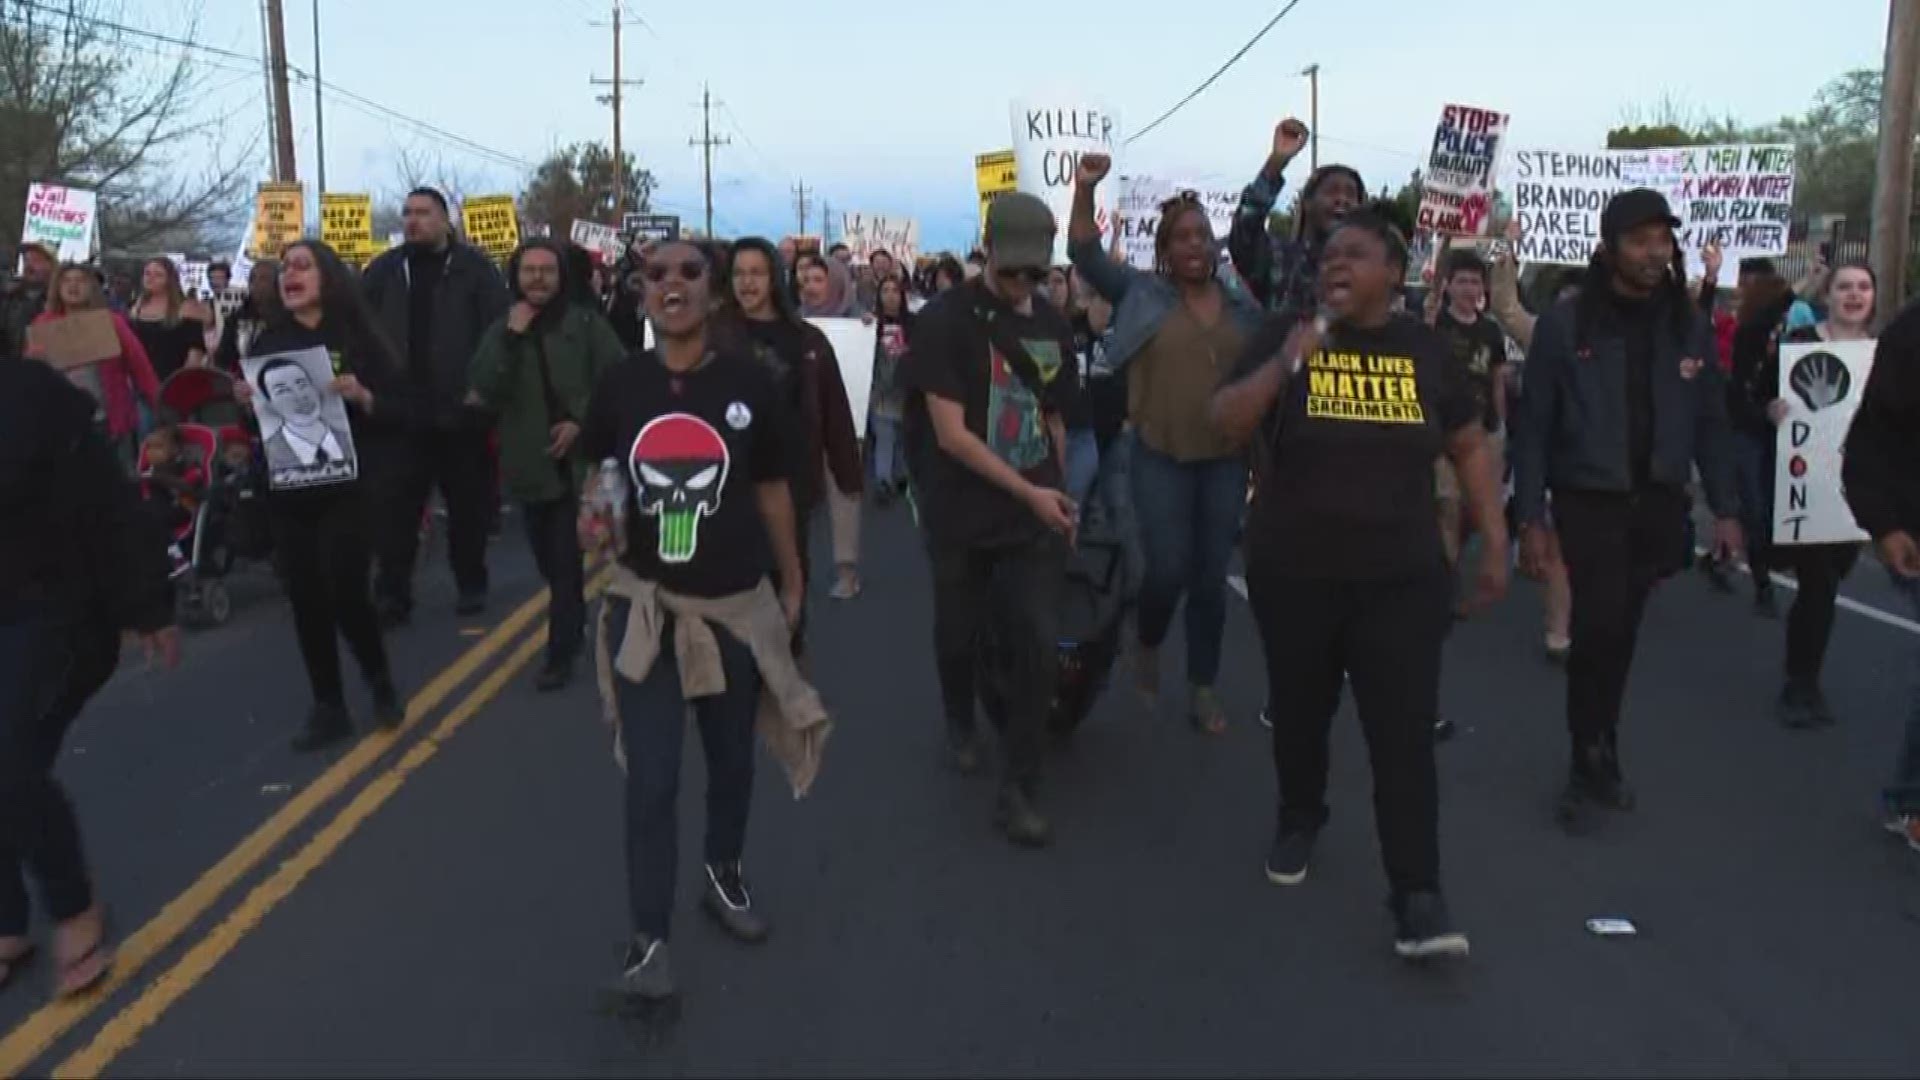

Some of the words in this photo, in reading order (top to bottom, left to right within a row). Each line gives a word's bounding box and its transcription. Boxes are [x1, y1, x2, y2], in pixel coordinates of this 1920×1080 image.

[1027, 108, 1112, 143] KILLER
[1517, 150, 1621, 180] STEPHON
[1705, 148, 1742, 171] MEN
[1747, 147, 1794, 173] MATTER
[34, 186, 68, 204] Jail
[1698, 173, 1741, 200] WOMEN
[1746, 174, 1792, 200] MATTER
[468, 209, 509, 222] BEING
[1418, 206, 1464, 231] CLARK
[1690, 200, 1726, 222] TRANS
[330, 219, 361, 229] STOP
[469, 220, 510, 232] BLACK
[323, 231, 369, 241] KILLING
[481, 231, 505, 242] NOT
[1735, 225, 1783, 250] MATTER
[1367, 355, 1415, 374] LIVES
[1309, 372, 1417, 401] MATTER
[1308, 398, 1422, 420] SACRAMENTO
[1782, 420, 1811, 541] DONT
